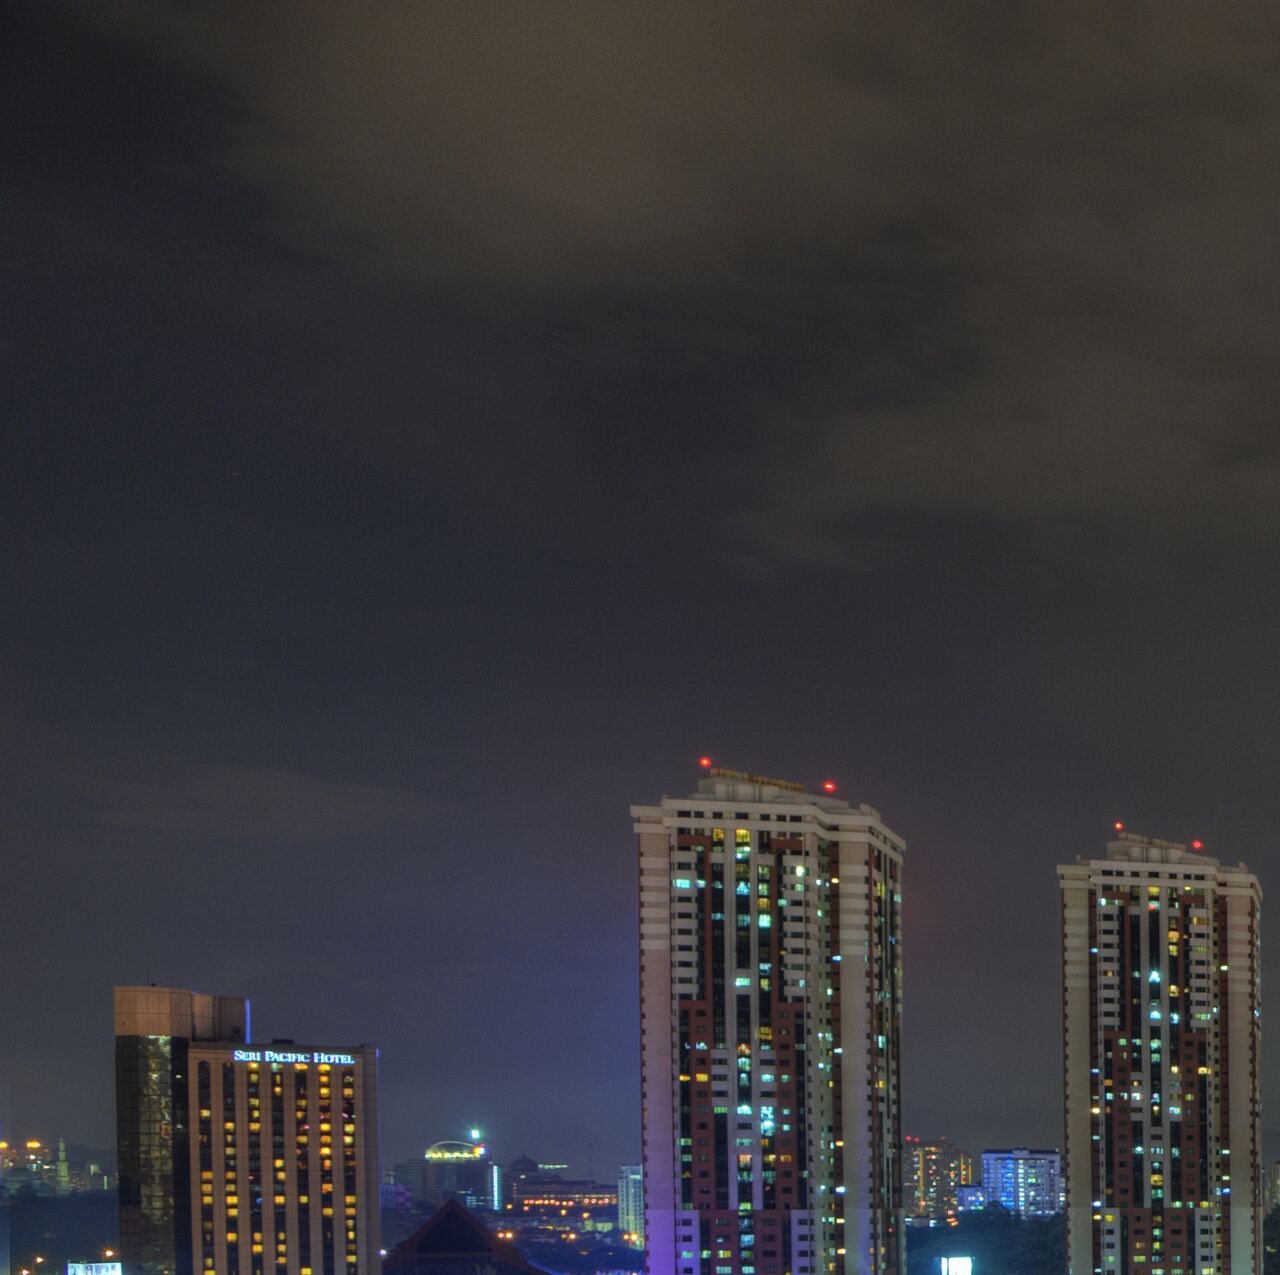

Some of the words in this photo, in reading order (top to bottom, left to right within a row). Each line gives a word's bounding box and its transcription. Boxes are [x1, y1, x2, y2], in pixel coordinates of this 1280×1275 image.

[233, 1050, 261, 1062] SERI
[264, 1051, 311, 1063] PACIFIC
[313, 1052, 355, 1065] HOTEL
